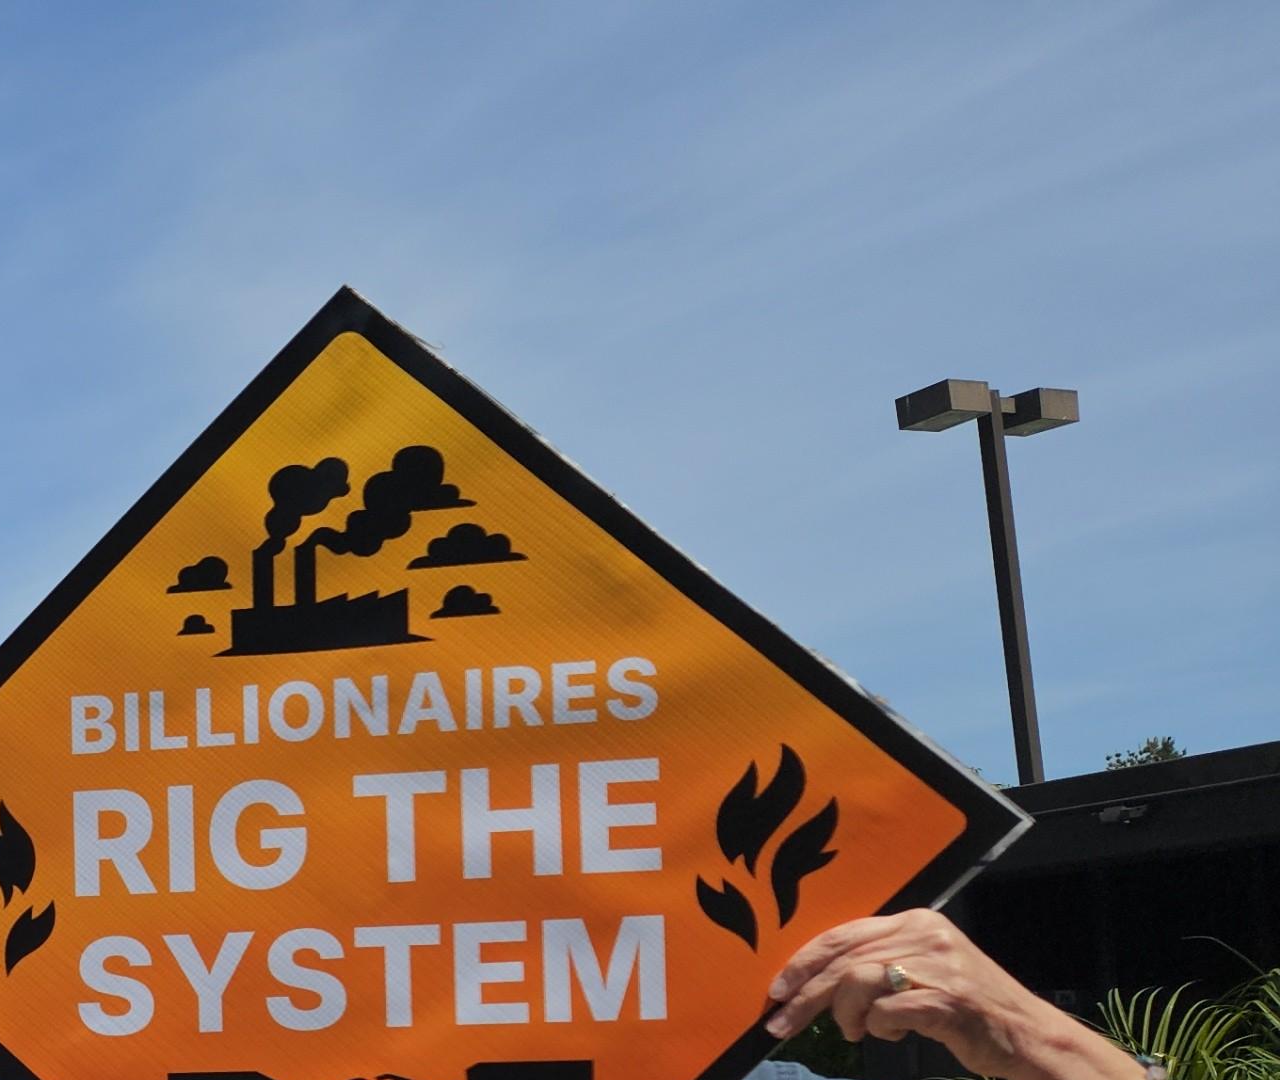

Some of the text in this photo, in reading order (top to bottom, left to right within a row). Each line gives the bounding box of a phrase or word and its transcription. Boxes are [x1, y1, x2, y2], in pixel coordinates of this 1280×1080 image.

[69, 656, 660, 755] BILLIONAIRES
[71, 757, 663, 899] RIG THE
[76, 914, 668, 1036] SYSTEM
